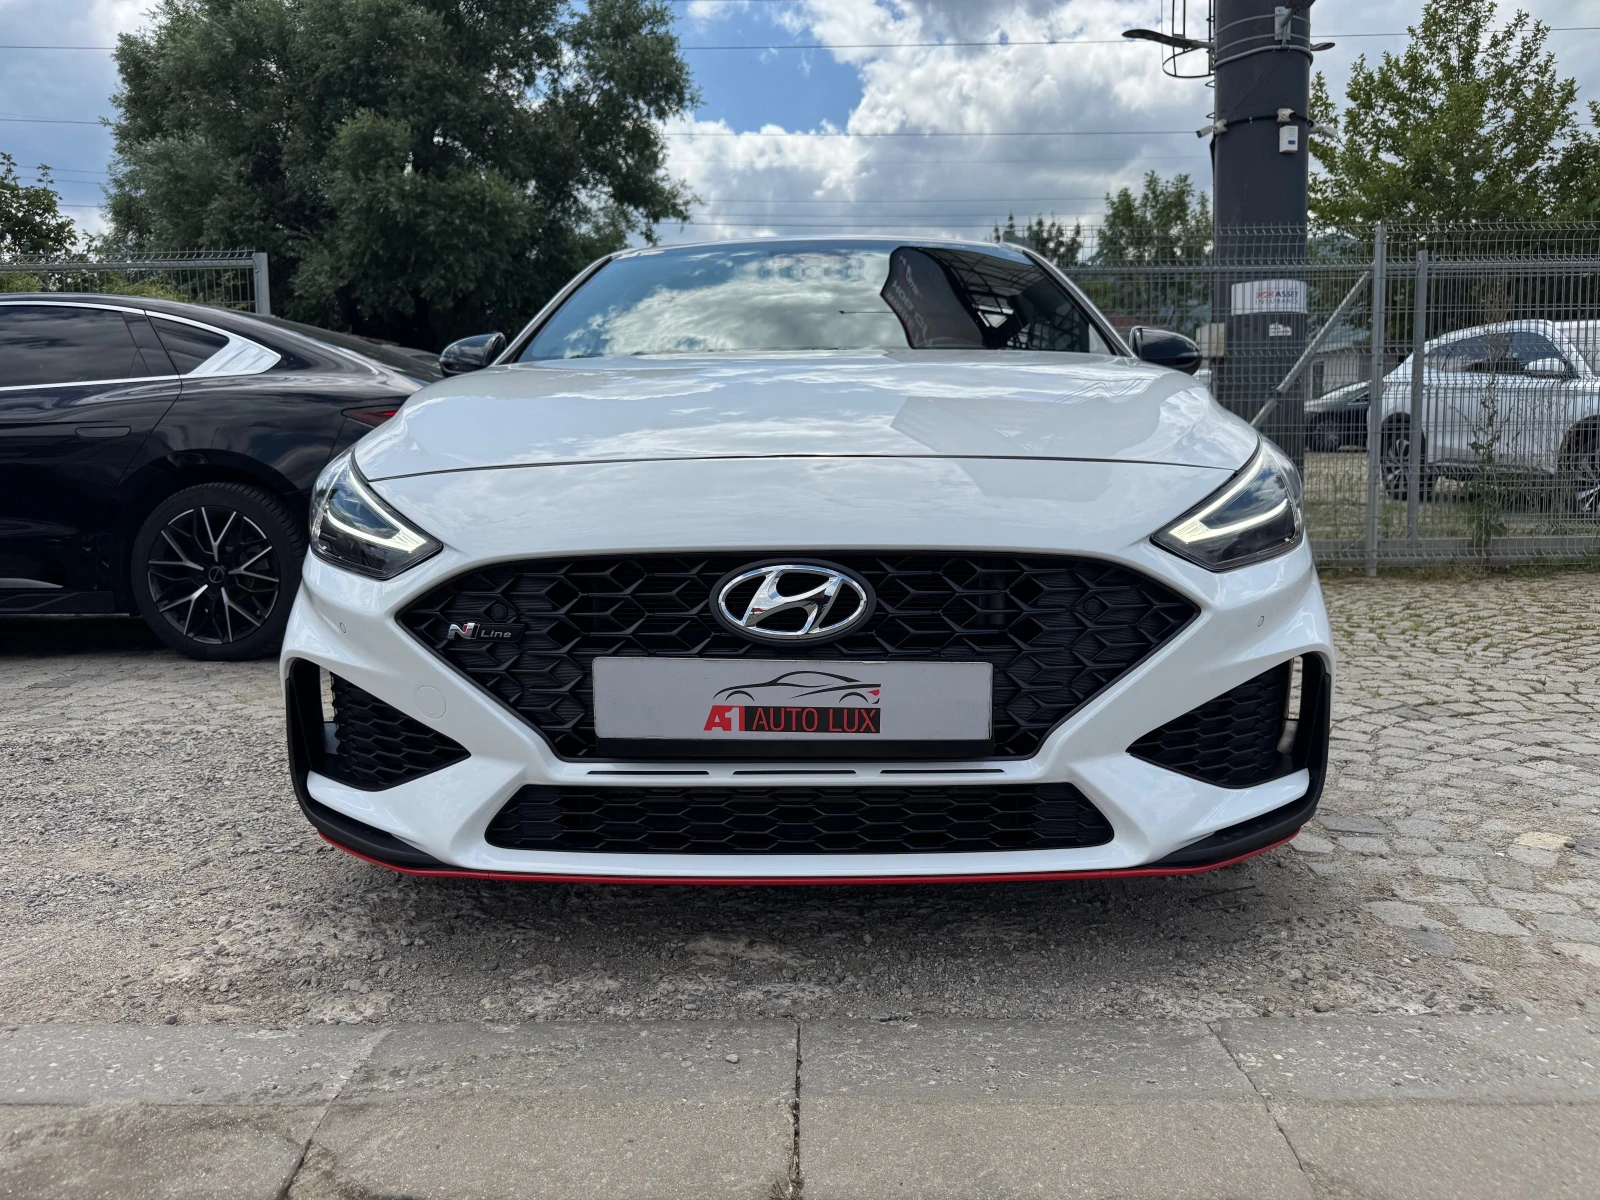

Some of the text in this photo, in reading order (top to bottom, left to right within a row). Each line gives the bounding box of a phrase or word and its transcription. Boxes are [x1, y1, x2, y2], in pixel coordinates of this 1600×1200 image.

[480, 629, 512, 638] Line
[703, 705, 877, 732] A1 AUTO LUX
